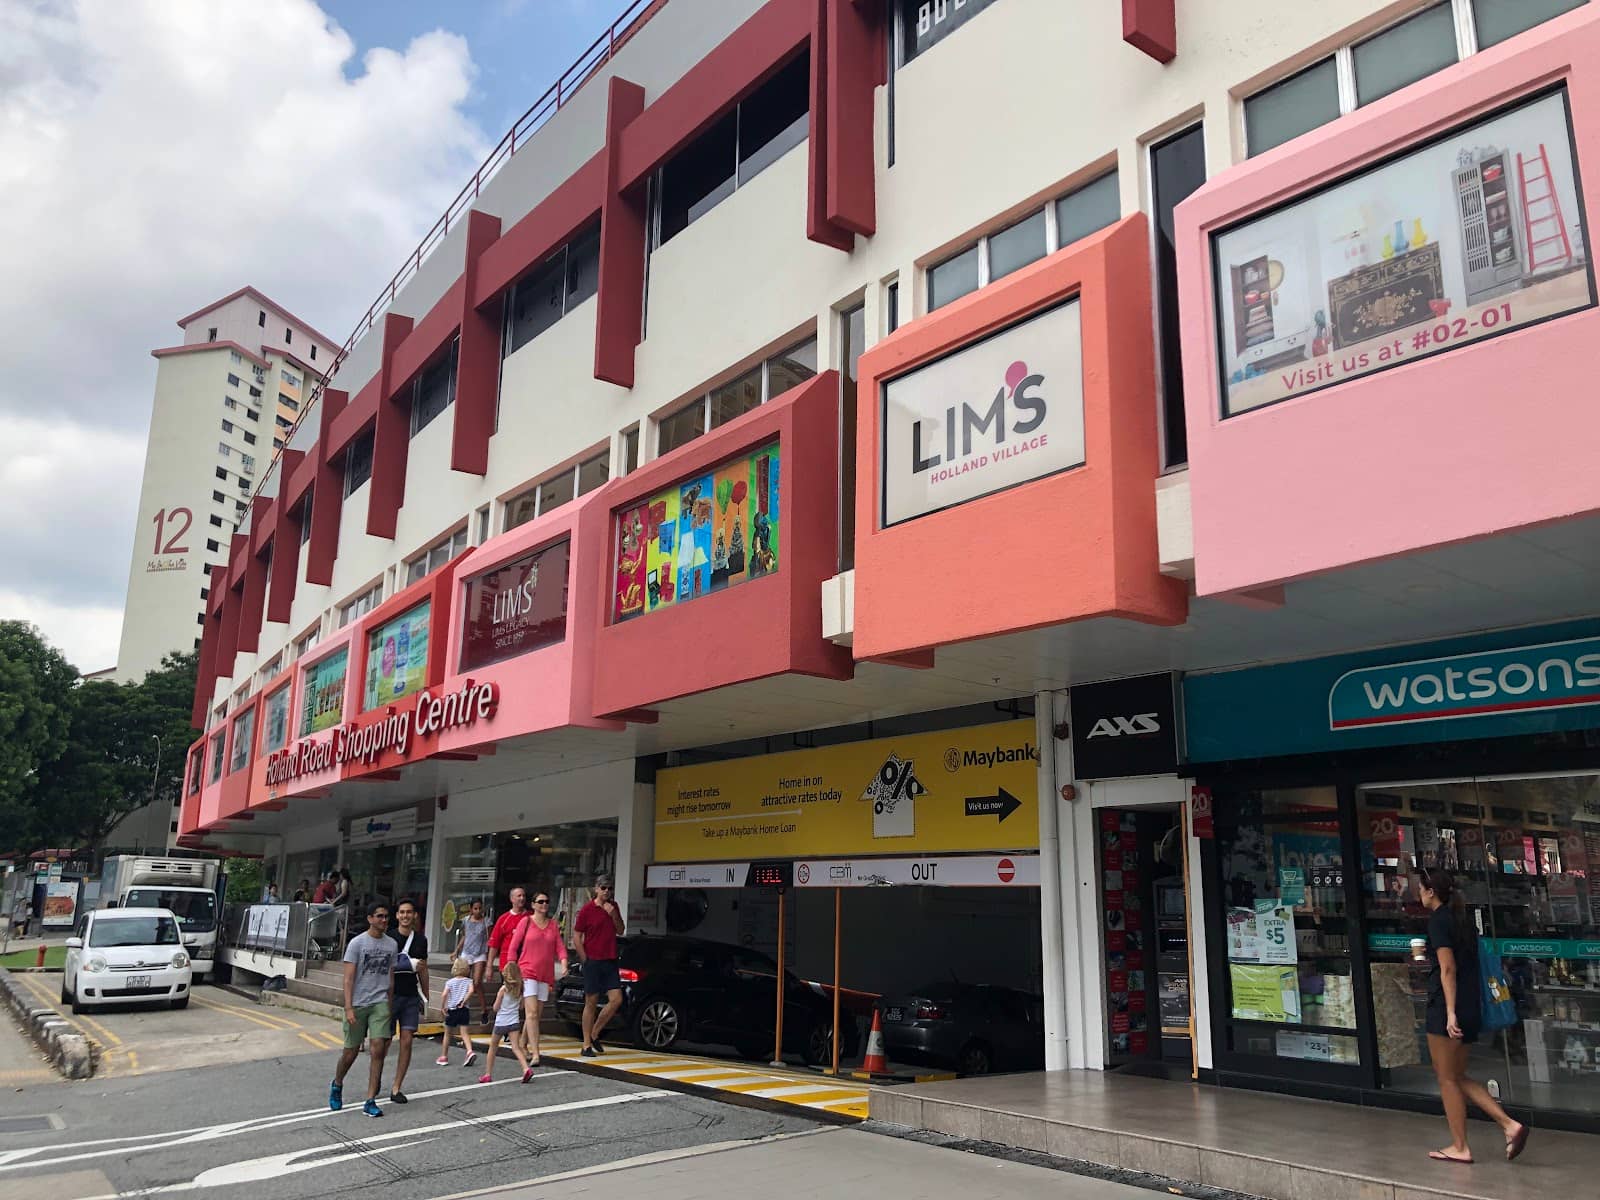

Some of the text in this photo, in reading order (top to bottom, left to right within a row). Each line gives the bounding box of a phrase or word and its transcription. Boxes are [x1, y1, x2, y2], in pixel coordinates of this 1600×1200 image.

[1282, 302, 1513, 391] Visit us at #02-01
[931, 434, 1048, 484] HOLLAND VILLAGE
[153, 507, 193, 555] 12
[1364, 654, 1600, 710] watsons
[266, 679, 493, 785] Holland Road Shopping Centre
[1086, 711, 1161, 741] AXS
[963, 743, 1037, 768] Maybank
[778, 775, 823, 790] Home in on
[677, 786, 720, 801] Interest rates
[760, 788, 842, 808] attractive rates today
[666, 799, 731, 818] might rise tomorrow
[968, 801, 1003, 811] Visit us now
[702, 827, 716, 838] Take
[716, 828, 724, 839] up
[729, 824, 758, 838] Maybank
[759, 824, 779, 835] Home
[780, 823, 796, 834] Loan
[1371, 817, 1394, 836] 20
[725, 868, 735, 883] IN
[911, 863, 937, 881] OUT
[1266, 927, 1285, 945] $5
[1510, 943, 1553, 952] watsons
